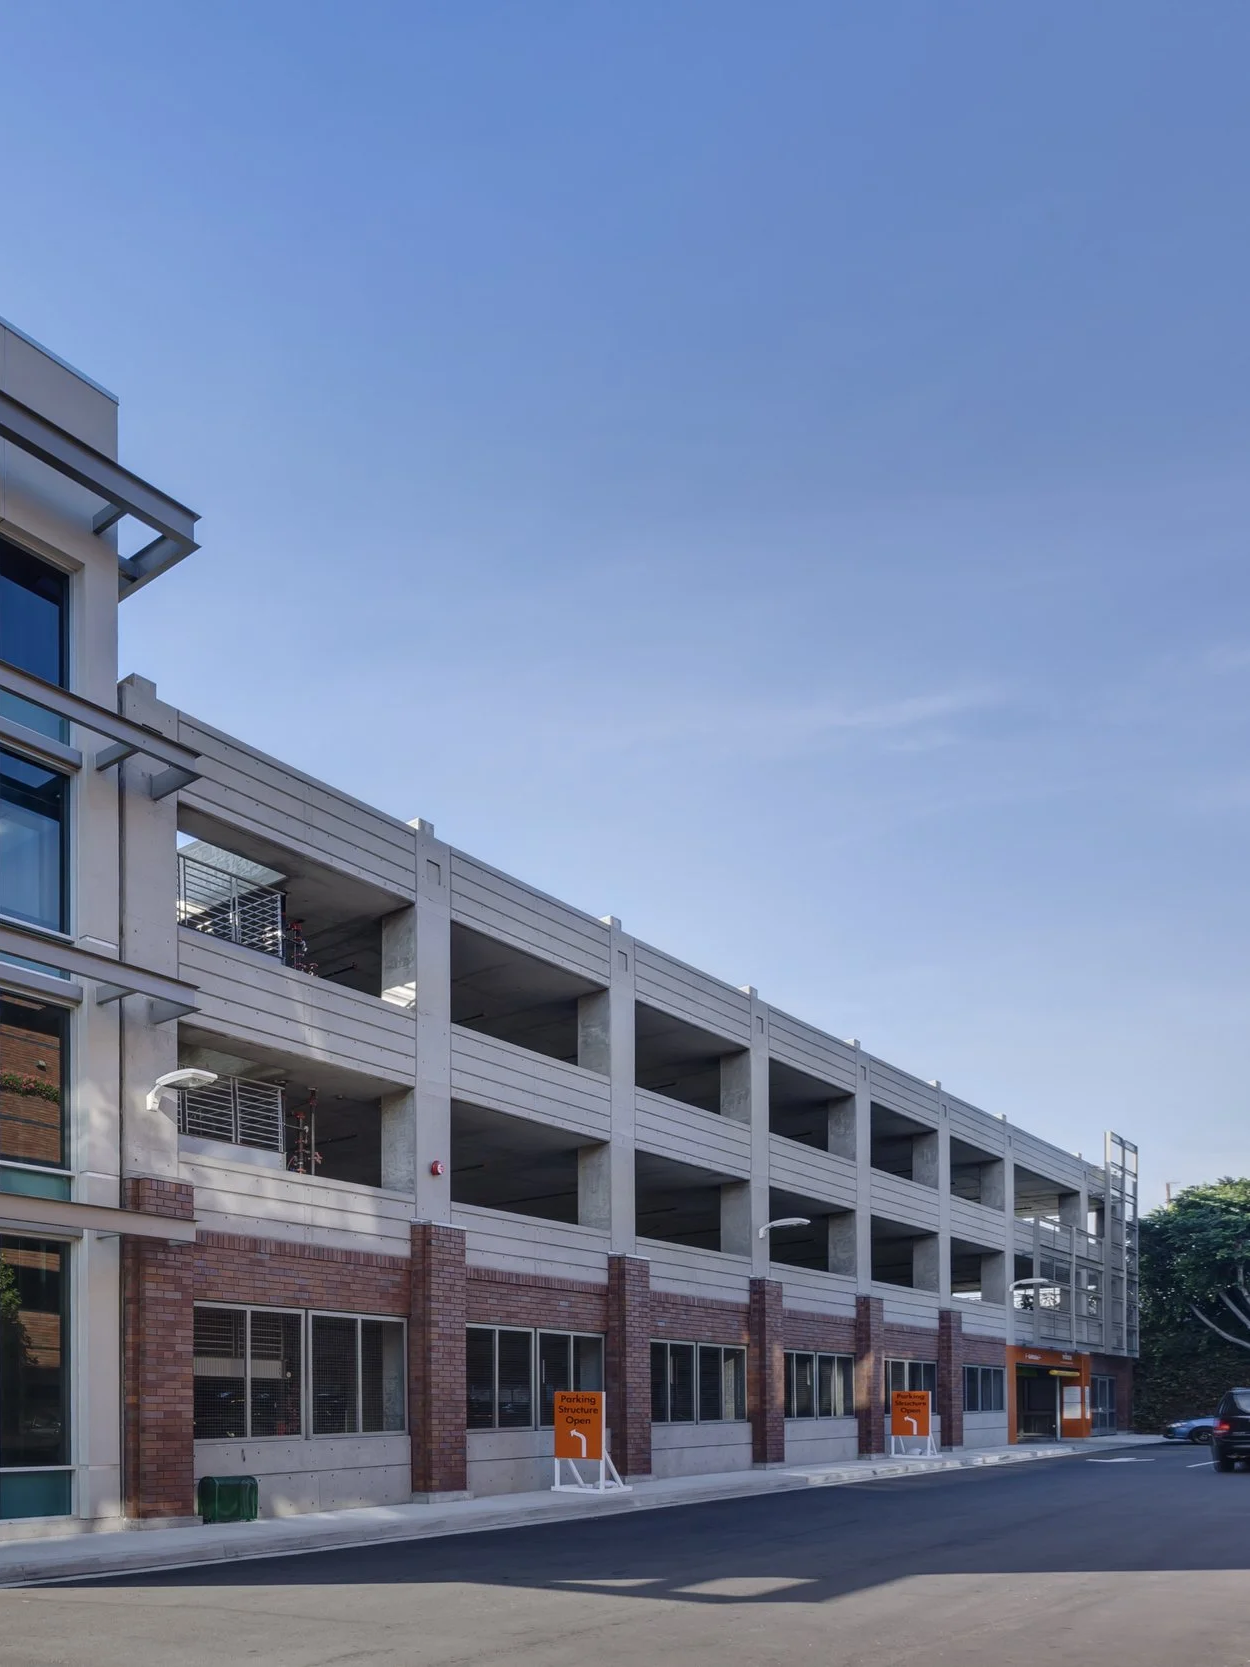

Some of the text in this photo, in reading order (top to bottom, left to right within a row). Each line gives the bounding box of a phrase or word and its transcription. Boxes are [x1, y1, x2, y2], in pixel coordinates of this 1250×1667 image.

[561, 1394, 596, 1405] Parking
[558, 1405, 599, 1414] Structure
[565, 1416, 591, 1426] Open
